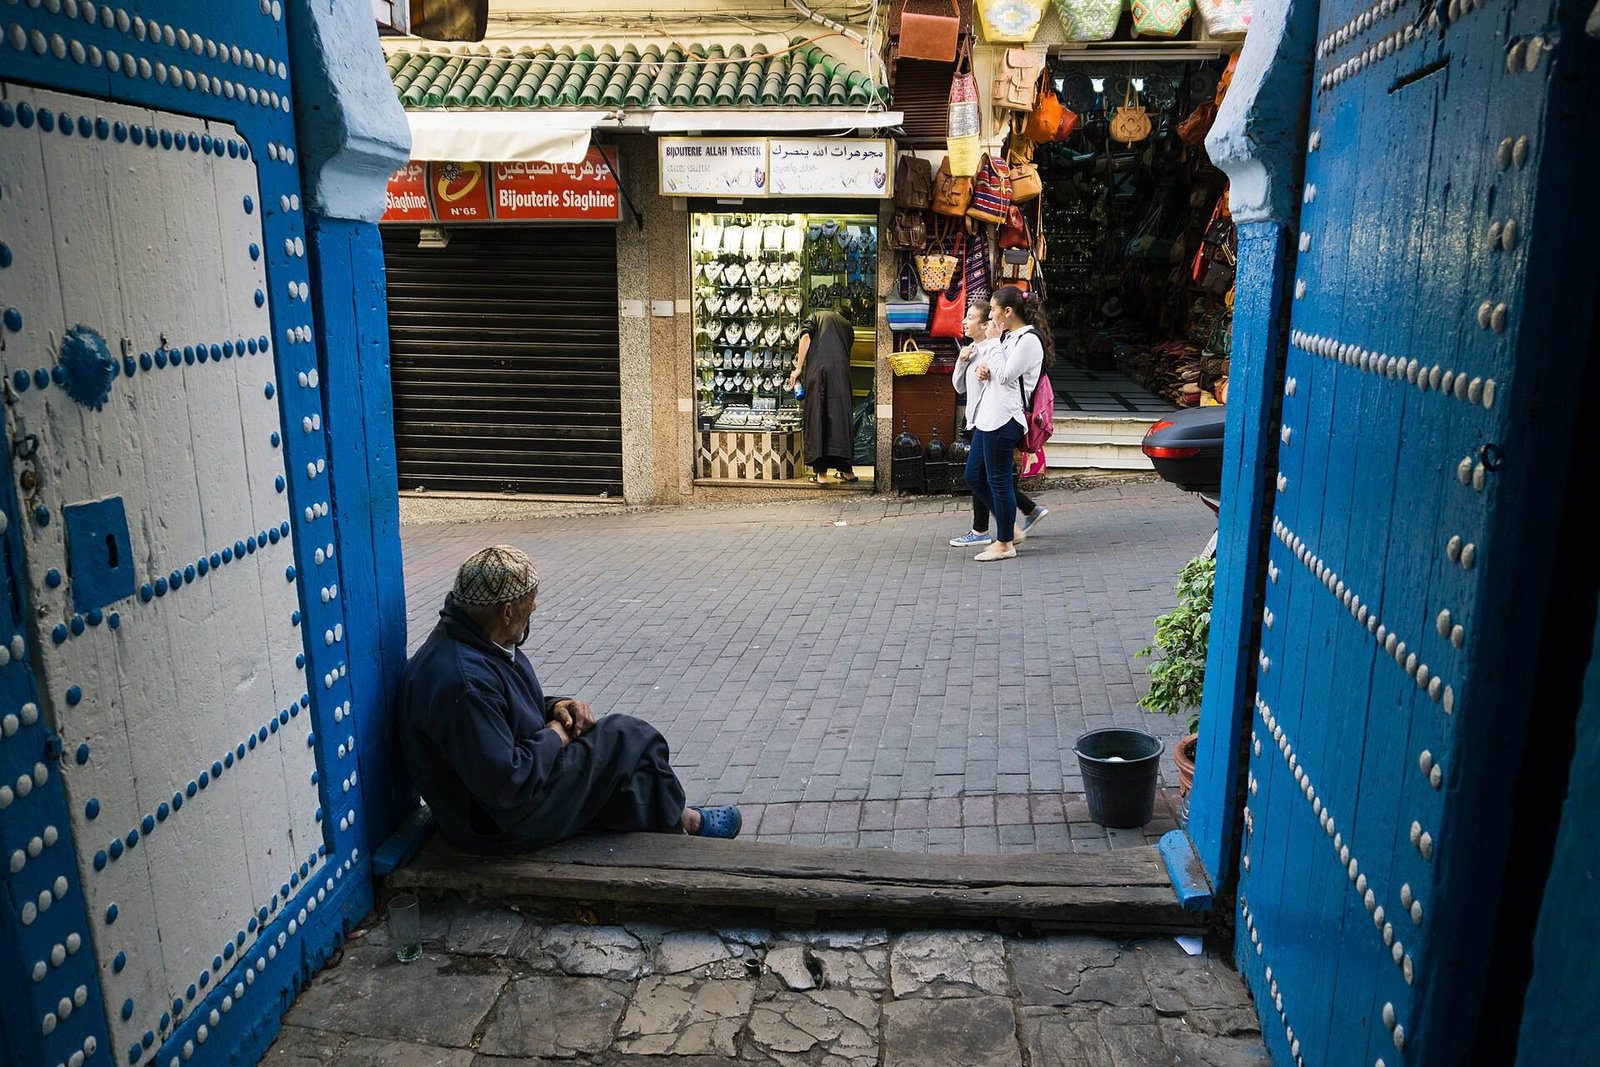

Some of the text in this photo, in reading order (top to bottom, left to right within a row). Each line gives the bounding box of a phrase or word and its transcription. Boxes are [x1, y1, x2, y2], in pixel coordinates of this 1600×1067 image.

[666, 146, 702, 158] BIJOUTERIE
[706, 146, 727, 156] ALLAH
[772, 144, 884, 160] مجوهرات الله ينصرك
[386, 191, 427, 213] Siaghine
[499, 189, 615, 211] Bijouterie Siaghine
